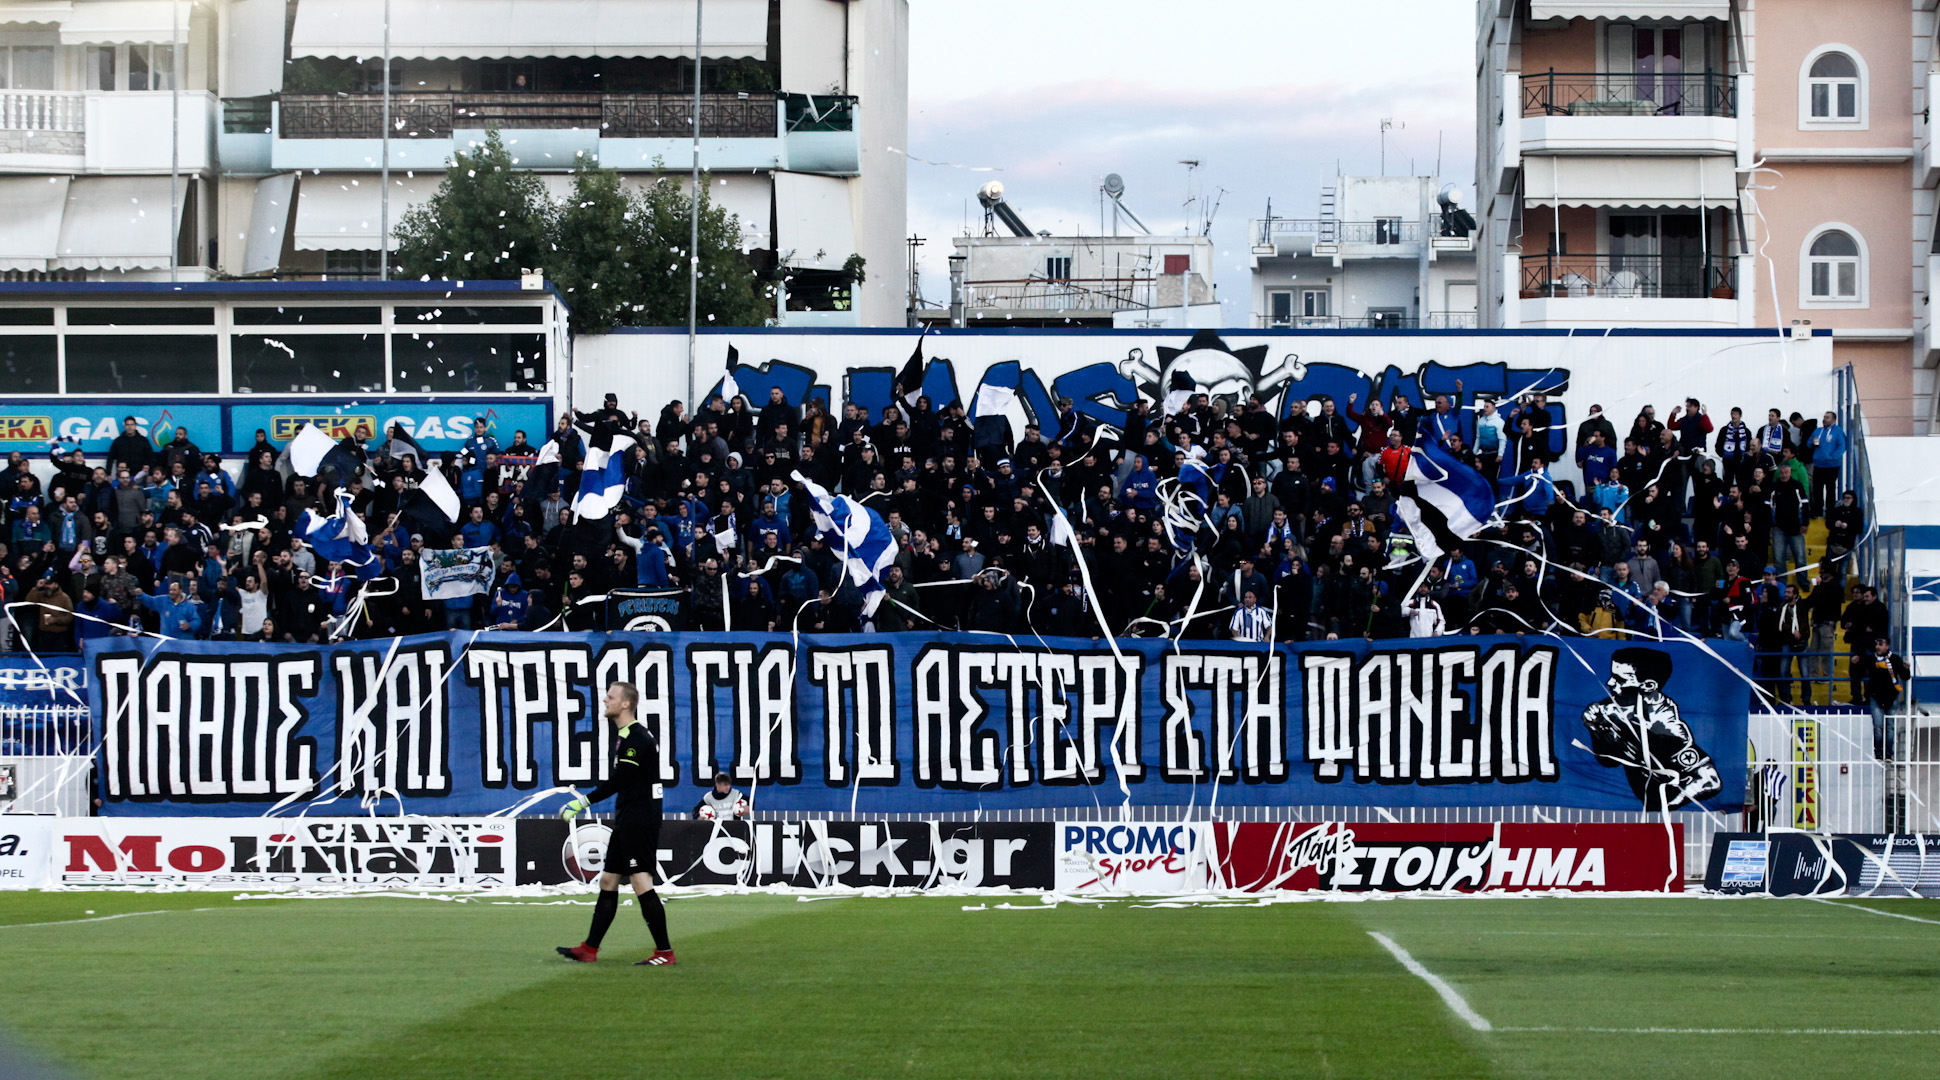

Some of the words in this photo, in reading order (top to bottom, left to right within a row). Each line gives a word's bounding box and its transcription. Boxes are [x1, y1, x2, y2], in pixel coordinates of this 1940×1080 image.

[383, 416, 474, 439] GAS
[333, 646, 449, 794] ΚΑΙ
[690, 647, 799, 783] ΓΙΑ
[811, 648, 898, 783] ΤΟ
[914, 647, 1142, 787] ΑΣΤΕΡΙ
[1302, 648, 1556, 779] ΦΑΝΕΛΑ
[63, 833, 505, 874] Molinari
[1064, 825, 1197, 855] PROMO
[1077, 846, 1189, 887] sport
